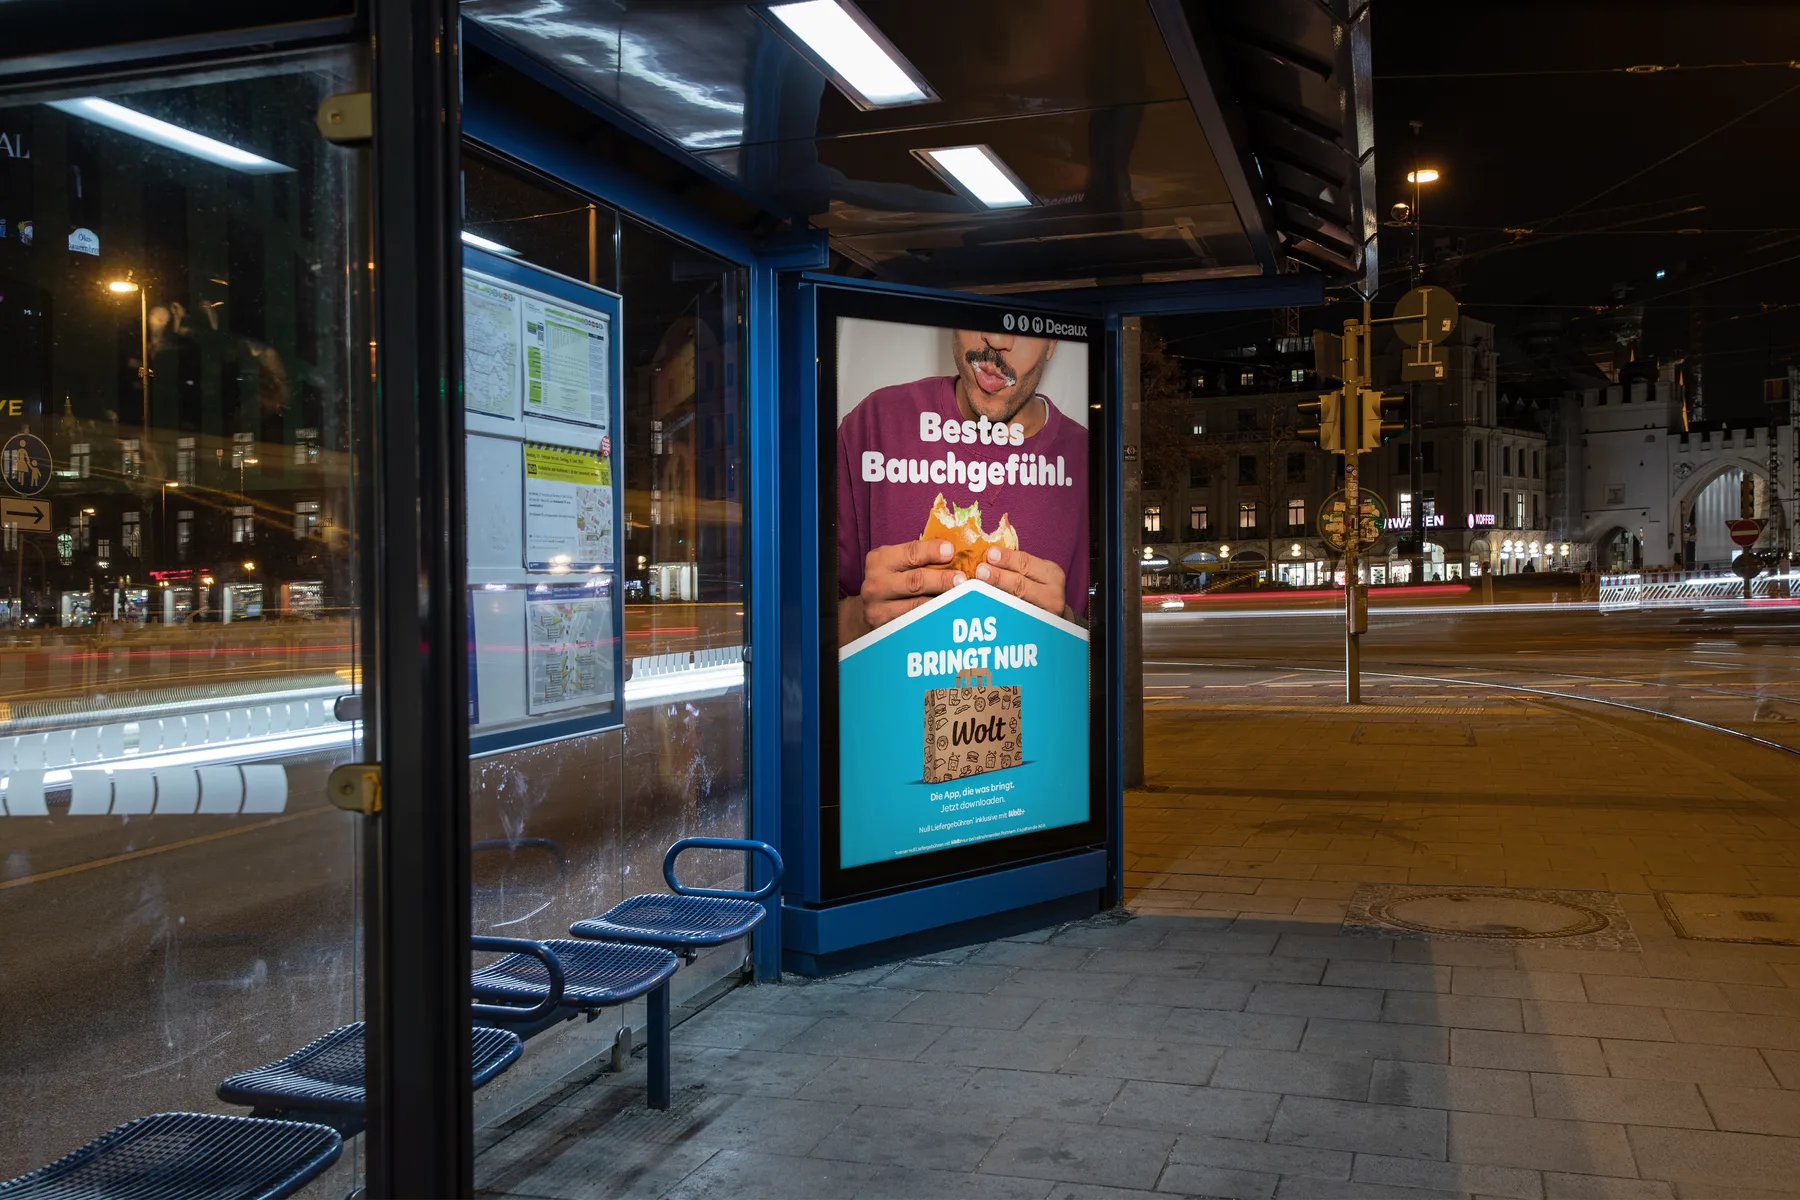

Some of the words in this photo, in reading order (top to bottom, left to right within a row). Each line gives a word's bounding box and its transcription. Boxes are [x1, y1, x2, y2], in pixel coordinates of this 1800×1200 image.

[1046, 319, 1088, 337] Decaux
[920, 411, 1025, 446] Bestes
[861, 451, 1073, 493] Bauchgefühl.
[1475, 514, 1495, 525] KOFFER
[953, 616, 997, 643] DAS
[907, 647, 991, 678] BRINGT
[994, 643, 1038, 670] NUR
[952, 715, 1006, 747] Wolt
[930, 792, 943, 802] Die
[944, 790, 961, 801] App,
[962, 787, 974, 797] die
[975, 785, 990, 794] was
[990, 781, 1015, 792] bringt.
[940, 803, 959, 813] Jetzt
[960, 796, 1006, 810] downloaden.
[919, 825, 930, 834] Null
[975, 815, 997, 824] inklusive
